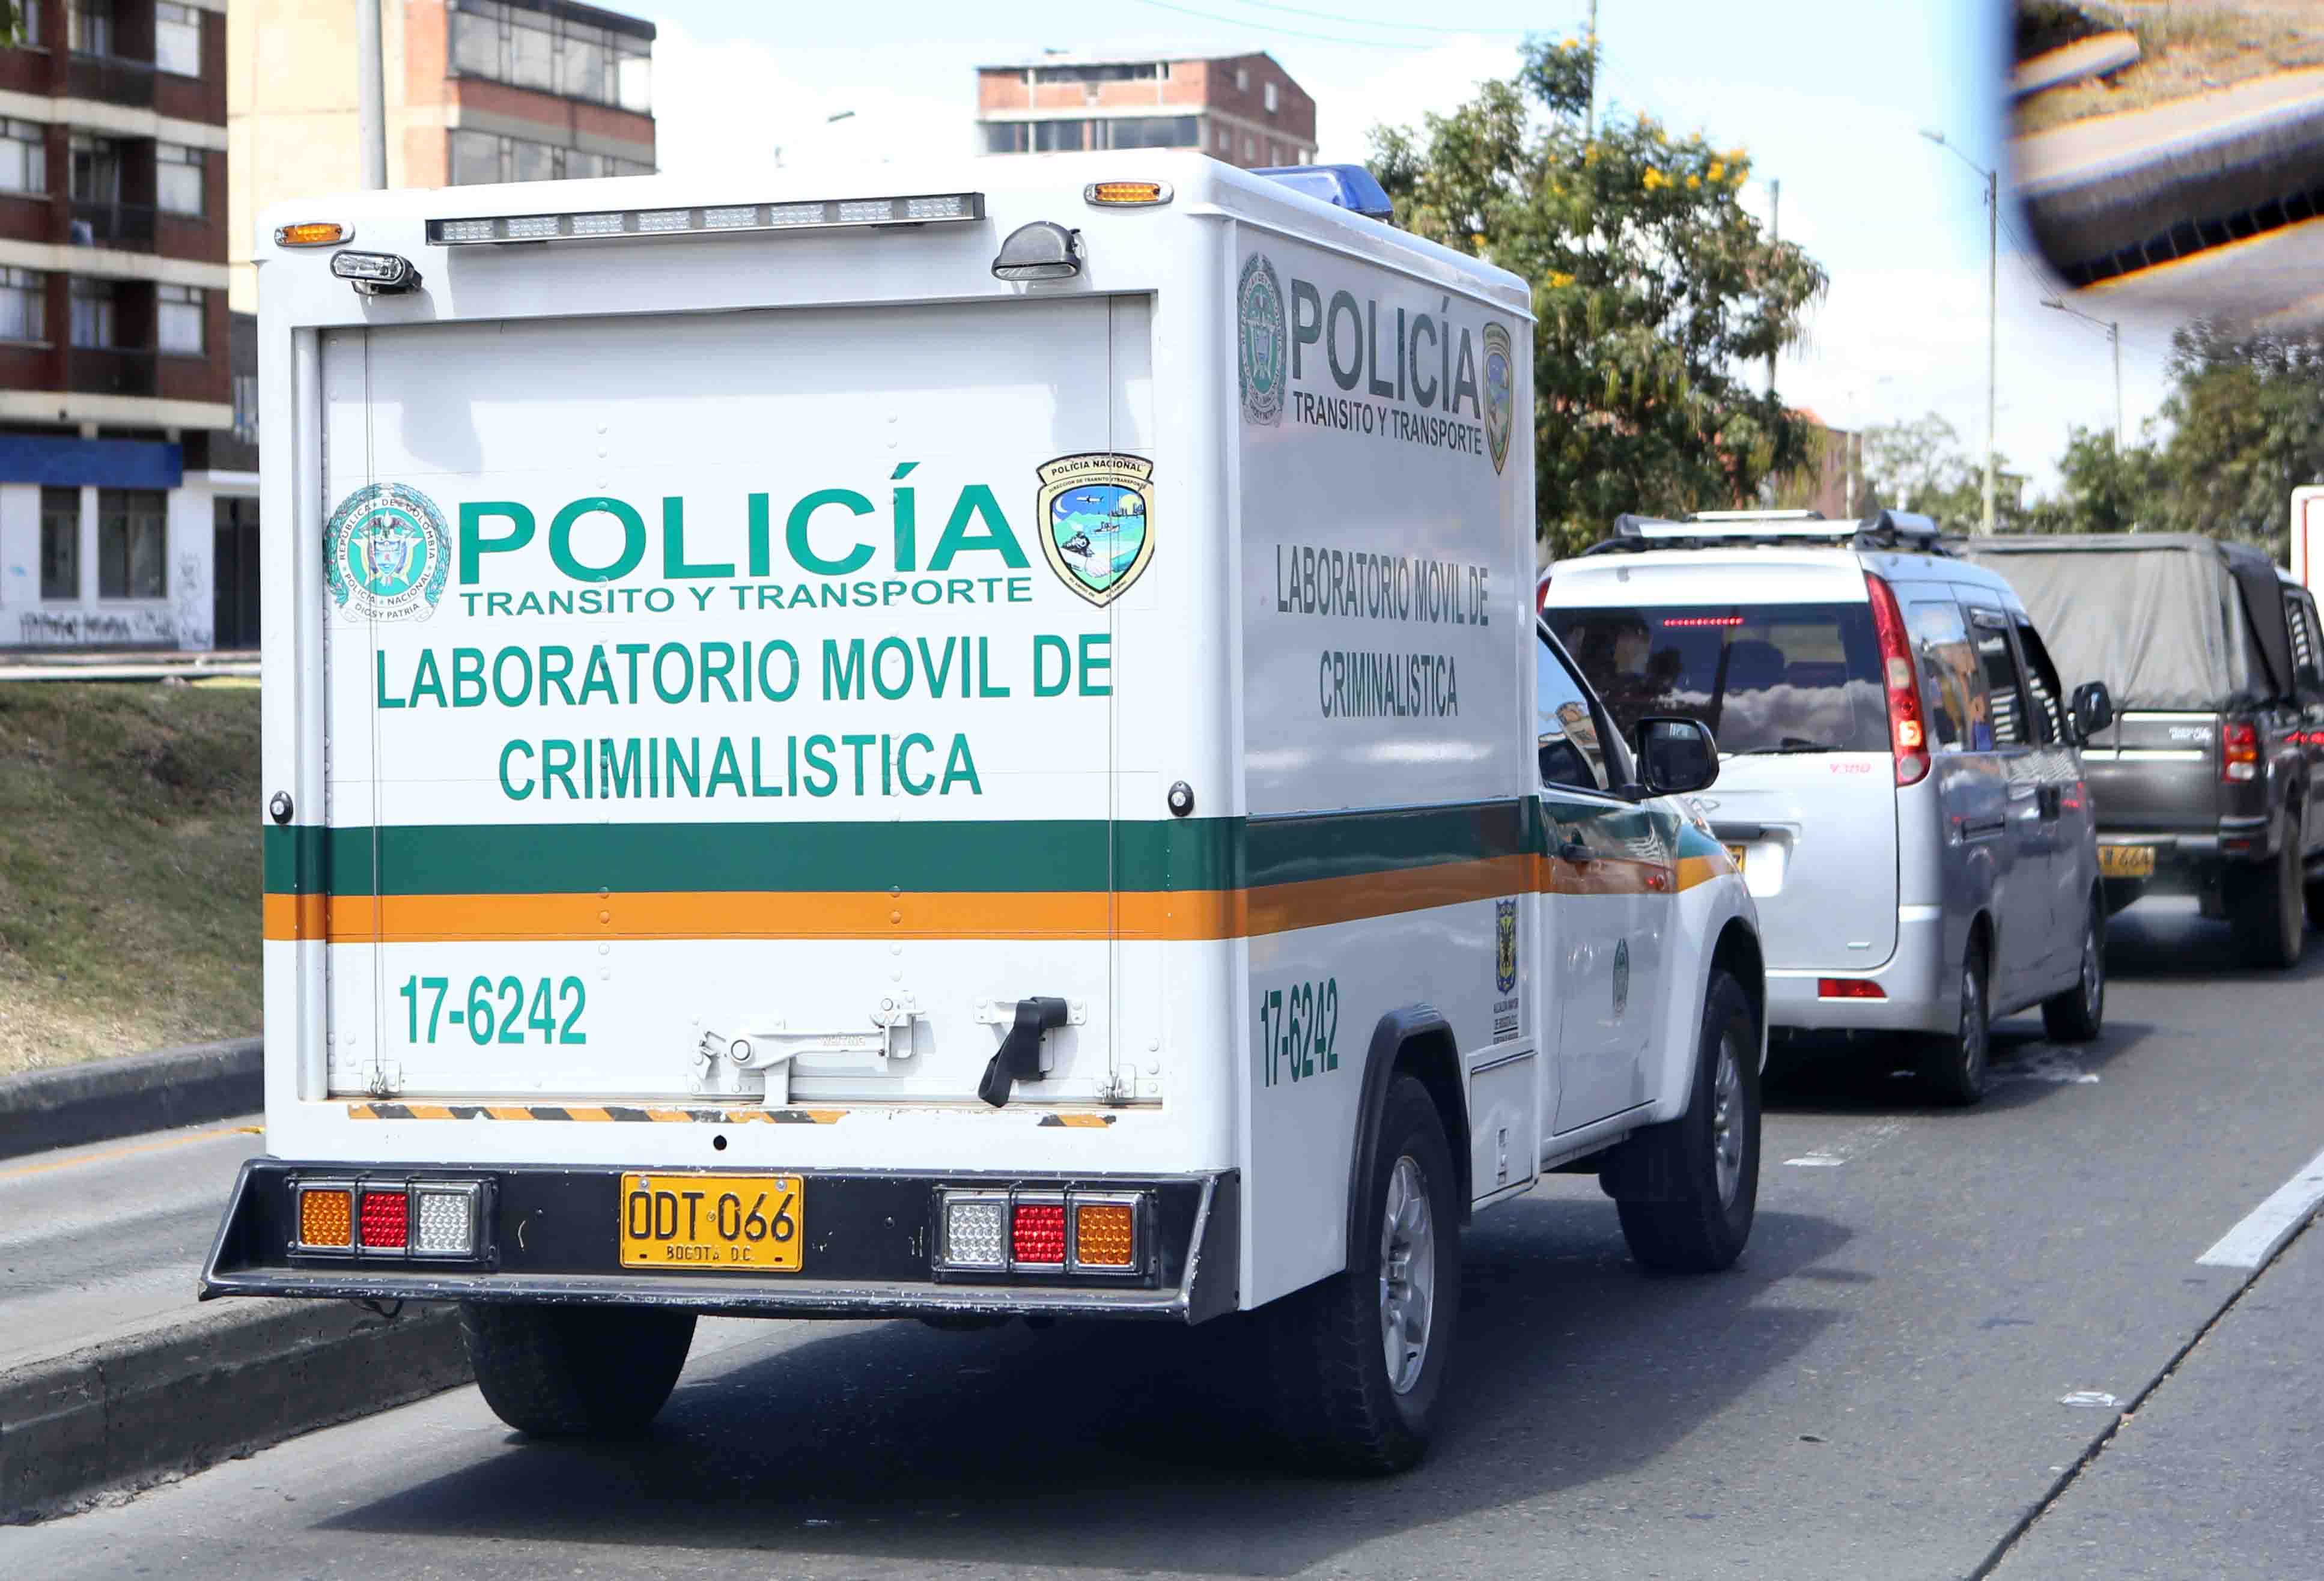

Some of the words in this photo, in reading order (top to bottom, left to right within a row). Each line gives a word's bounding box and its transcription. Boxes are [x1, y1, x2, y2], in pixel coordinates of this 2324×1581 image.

[1291, 278, 1481, 419] POLICÍA
[1293, 390, 1373, 434] TRANSITO
[1378, 406, 1387, 436] Y
[1392, 409, 1482, 455] TRANSPORTE
[1094, 461, 1142, 472] NACIONAL
[459, 461, 1032, 584] POLICÍA
[355, 602, 377, 618] DIOS
[387, 603, 420, 619] PATRIA
[388, 572, 431, 605] NACIONAL
[460, 586, 675, 616] TRANSITO
[688, 586, 716, 611] Y
[729, 577, 1033, 610] TRANSPORTE
[1277, 544, 1410, 621] LABORATORIO
[1415, 559, 1465, 624] MOVIL
[1469, 565, 1488, 626] DE
[377, 639, 800, 708] LABORATORIO
[822, 634, 1011, 702] MOVIL
[1033, 633, 1114, 699] DE
[1320, 650, 1458, 718] CRIMINALISTICA
[499, 732, 983, 801] CRIMINALISTICA
[400, 974, 587, 1046] 17-6242
[1261, 977, 1338, 1087] 17-6242
[628, 1191, 705, 1240] ODT
[718, 1192, 795, 1242] 066
